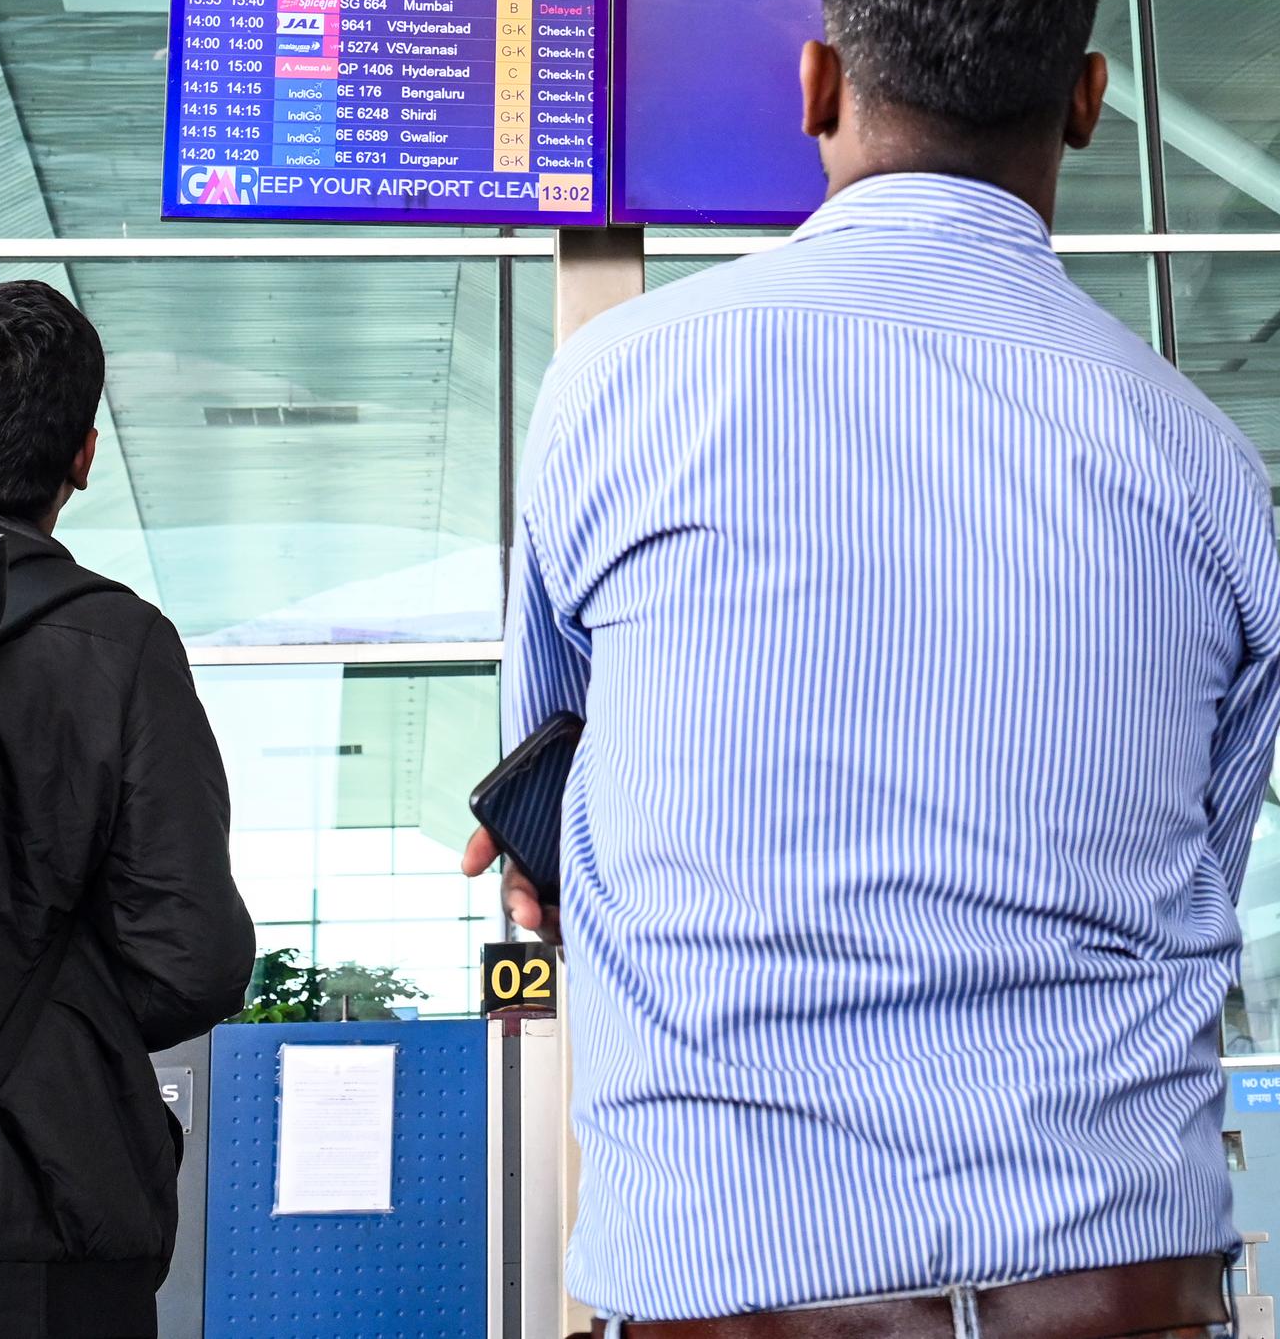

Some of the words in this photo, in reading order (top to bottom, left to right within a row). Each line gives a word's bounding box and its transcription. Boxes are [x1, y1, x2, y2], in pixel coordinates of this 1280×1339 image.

[181, 148, 216, 160] 14:20
[224, 149, 259, 161] 14:20
[335, 151, 352, 163] 6E
[356, 151, 386, 164] 6731
[400, 153, 459, 167] Durgapur
[499, 155, 523, 167] G-K
[309, 177, 371, 195] YOUR
[377, 179, 474, 197] AIRPORT
[542, 186, 589, 201] 13:02
[491, 959, 550, 999] 02
[1242, 1078, 1258, 1088] NO
